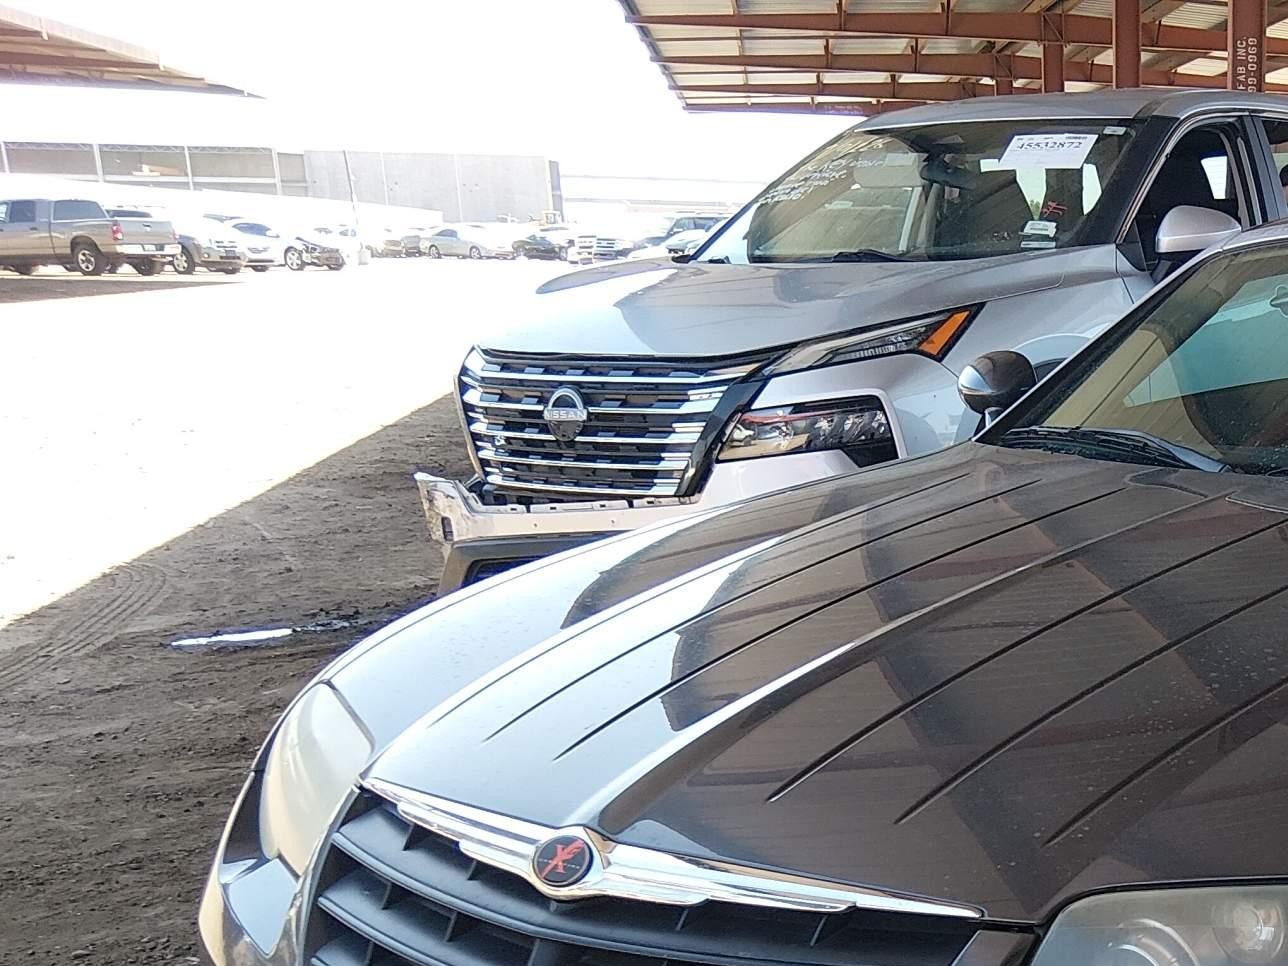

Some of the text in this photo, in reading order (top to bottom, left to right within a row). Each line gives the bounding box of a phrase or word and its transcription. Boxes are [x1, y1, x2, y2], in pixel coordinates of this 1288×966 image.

[1236, 36, 1247, 90] FAB INC.
[544, 409, 587, 420] NISSAN
